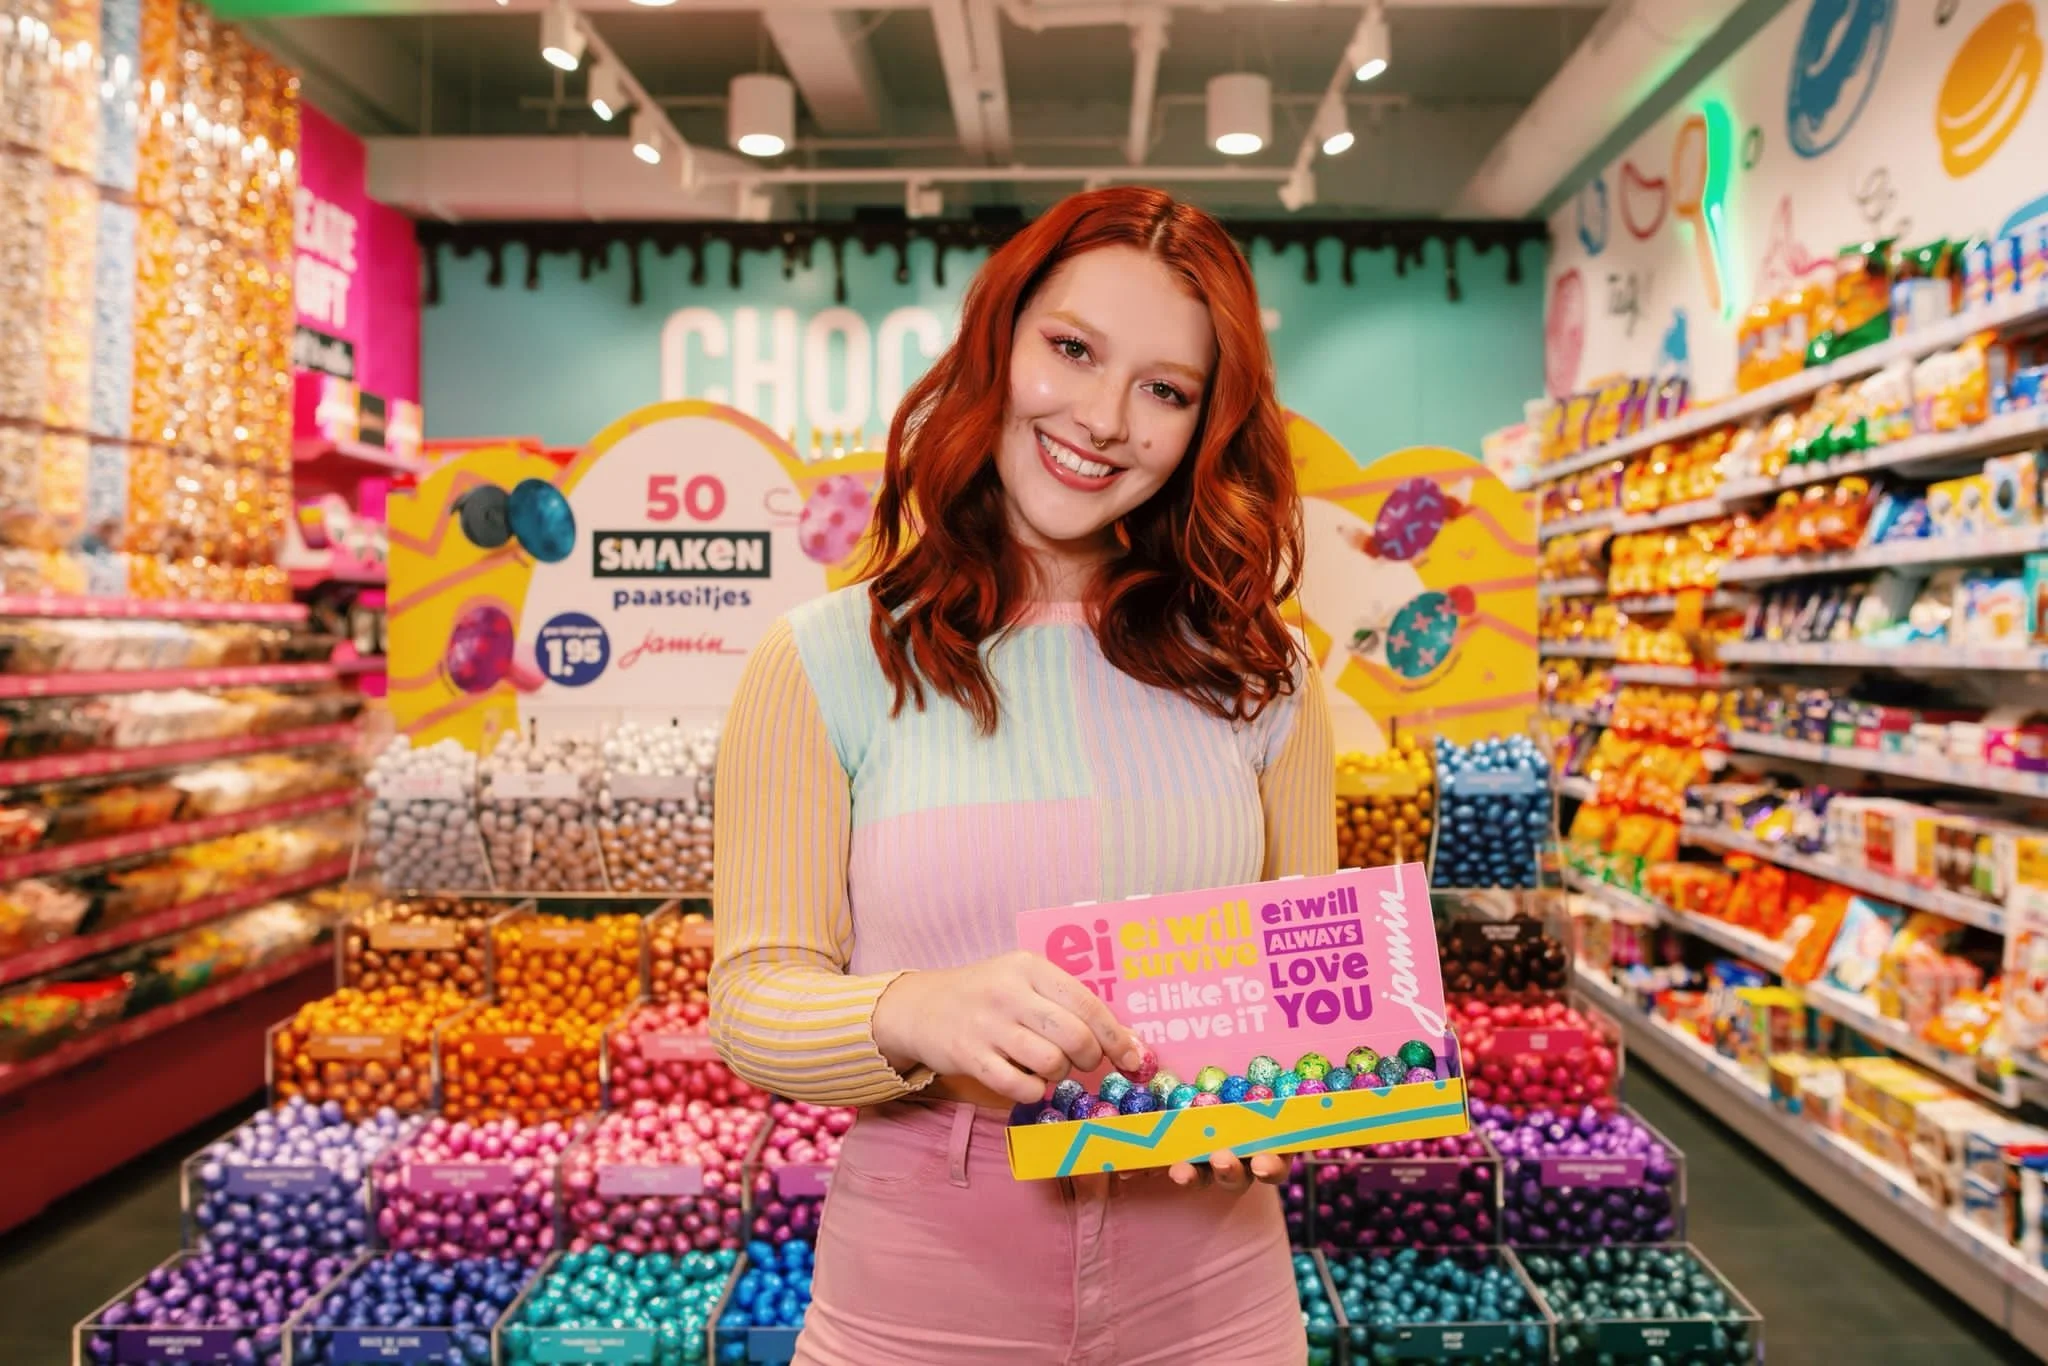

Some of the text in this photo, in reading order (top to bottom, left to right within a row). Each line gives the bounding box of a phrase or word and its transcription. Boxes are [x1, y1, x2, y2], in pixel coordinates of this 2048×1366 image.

[646, 474, 726, 522] 50
[613, 587, 751, 611] paaseitjes
[617, 629, 747, 669] jamin
[1295, 886, 1359, 920] will
[1119, 898, 1252, 951] ei will
[1269, 924, 1359, 952] ALWAYS
[1046, 919, 1115, 976] ei
[1122, 942, 1259, 980] survive
[1375, 864, 1447, 1037] jamin
[1127, 986, 1158, 1014] ei
[1160, 980, 1223, 1011] like
[1274, 984, 1373, 1028] YOU
[1132, 1013, 1234, 1044] move
